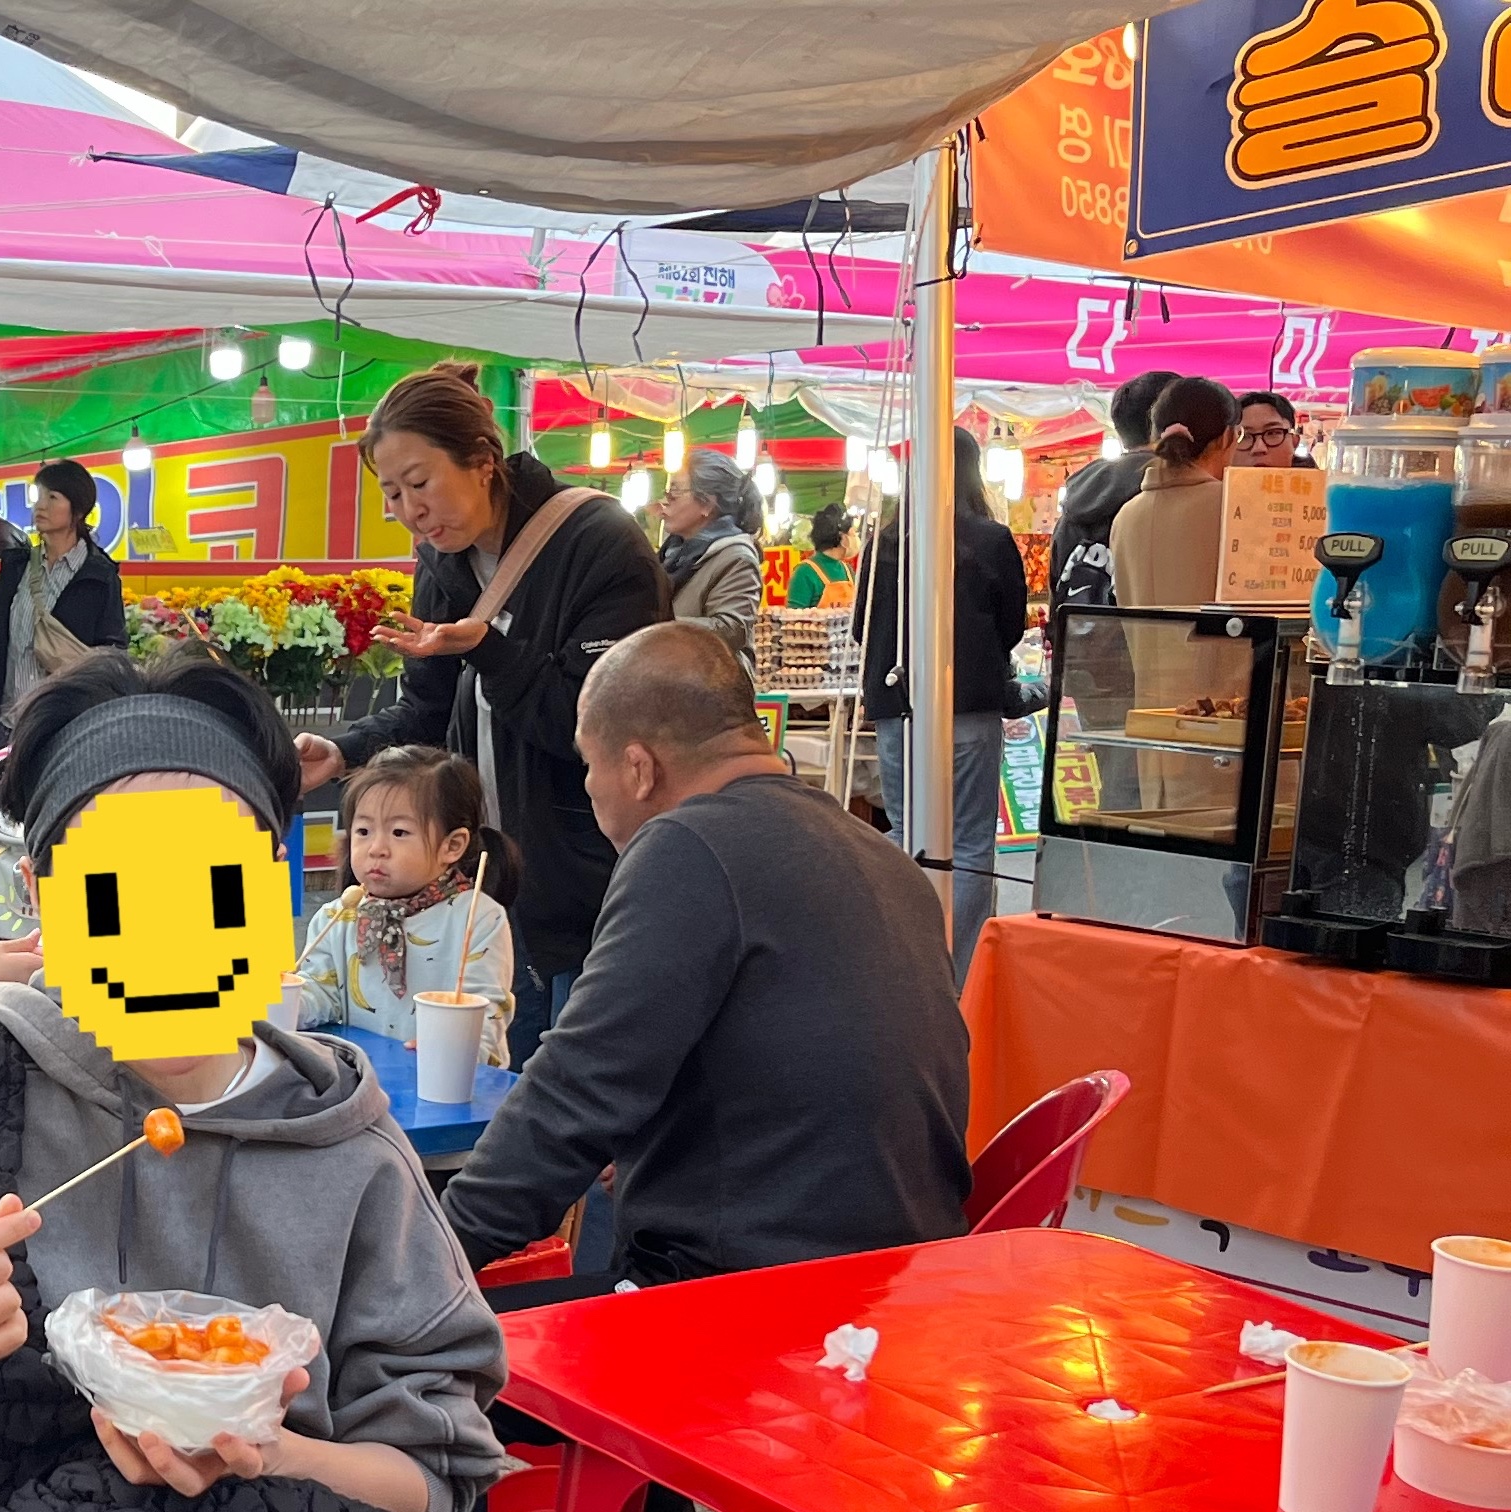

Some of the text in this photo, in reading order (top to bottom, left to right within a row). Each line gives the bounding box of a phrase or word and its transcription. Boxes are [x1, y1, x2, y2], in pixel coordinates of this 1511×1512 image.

[703, 266, 735, 289] 진해
[1233, 506, 1242, 520] A
[1231, 538, 1240, 553] B
[1330, 539, 1366, 553] PULL
[1460, 542, 1498, 557] PULL
[1228, 572, 1237, 586] C
